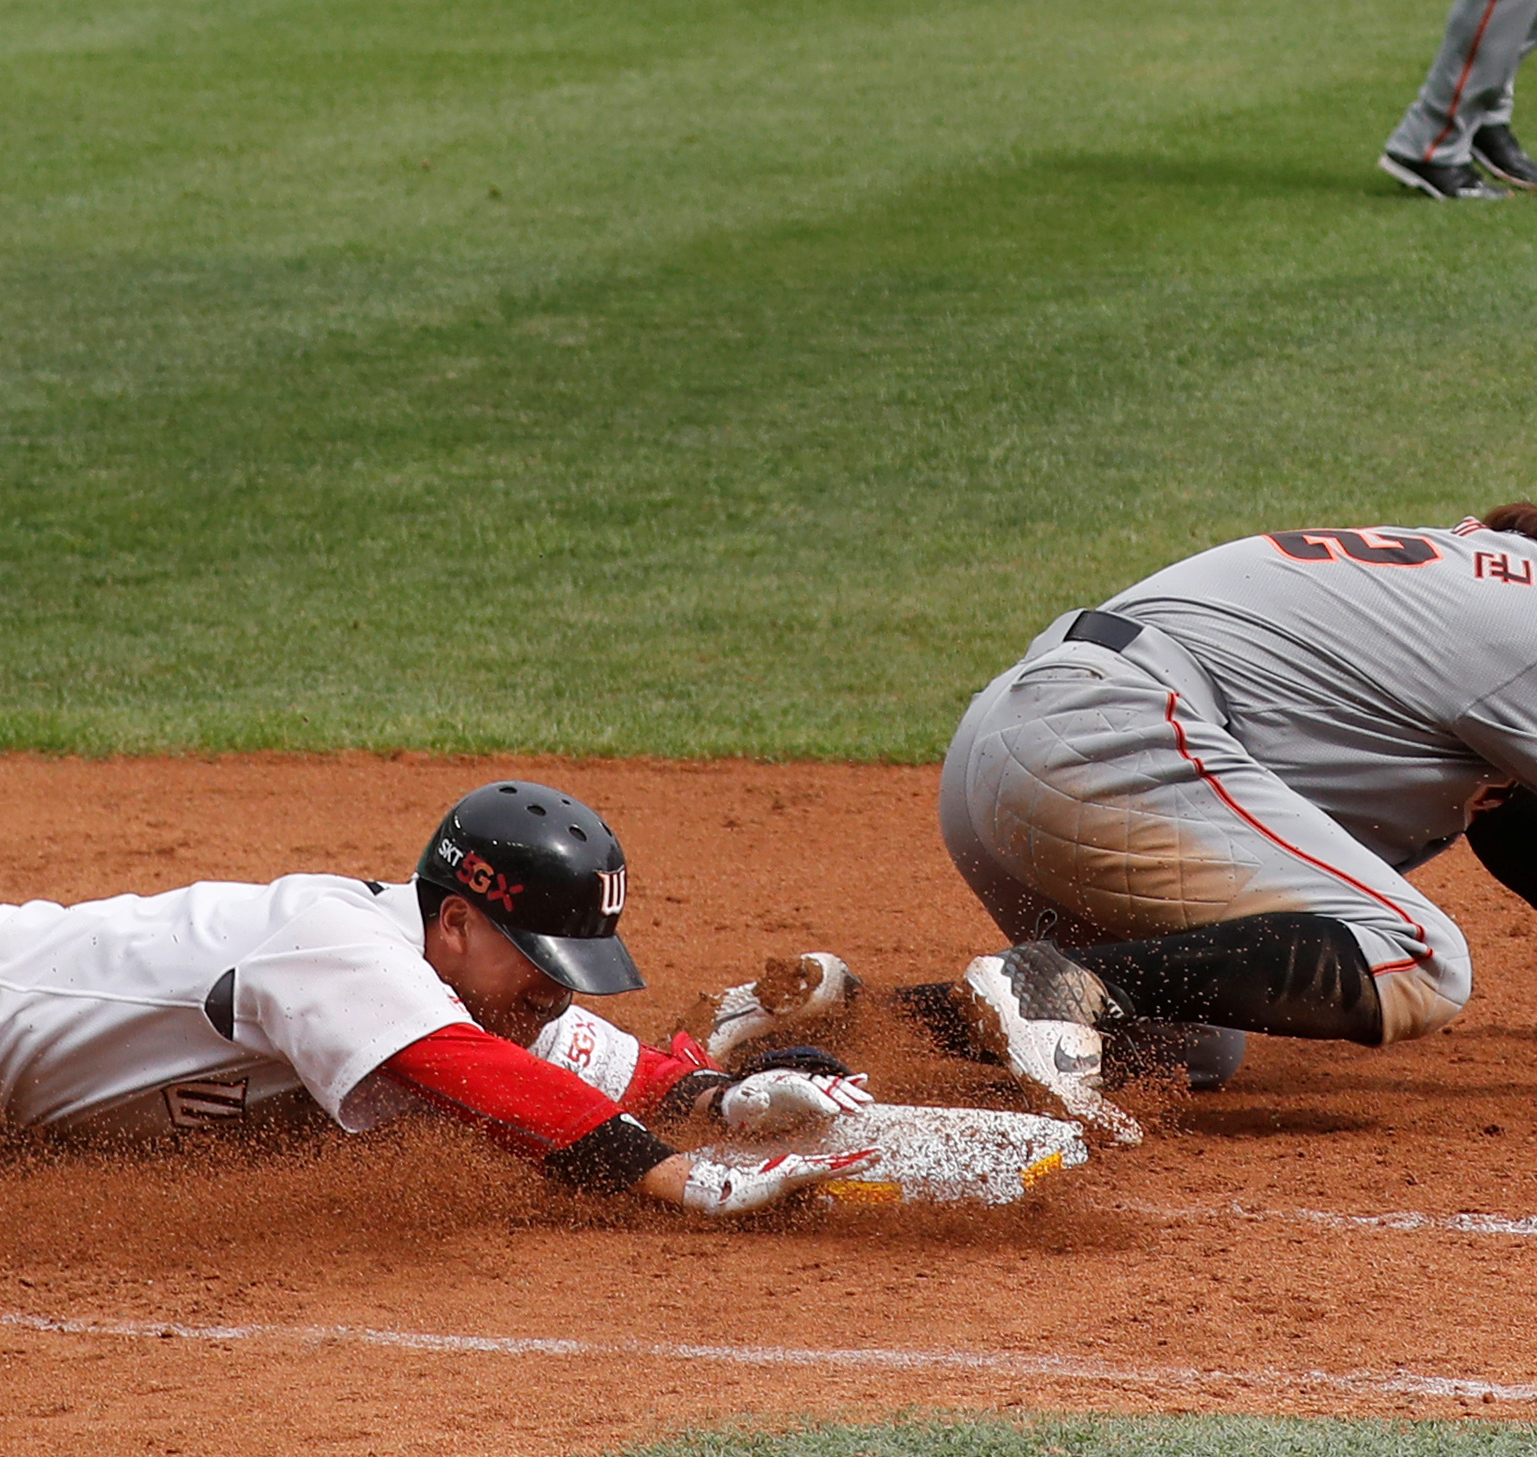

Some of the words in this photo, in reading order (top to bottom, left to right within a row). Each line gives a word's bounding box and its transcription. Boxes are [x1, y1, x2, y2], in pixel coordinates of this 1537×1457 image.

[438, 838, 464, 866] SKT
[455, 853, 524, 912] 5GX
[567, 1012, 598, 1068] 5GX
